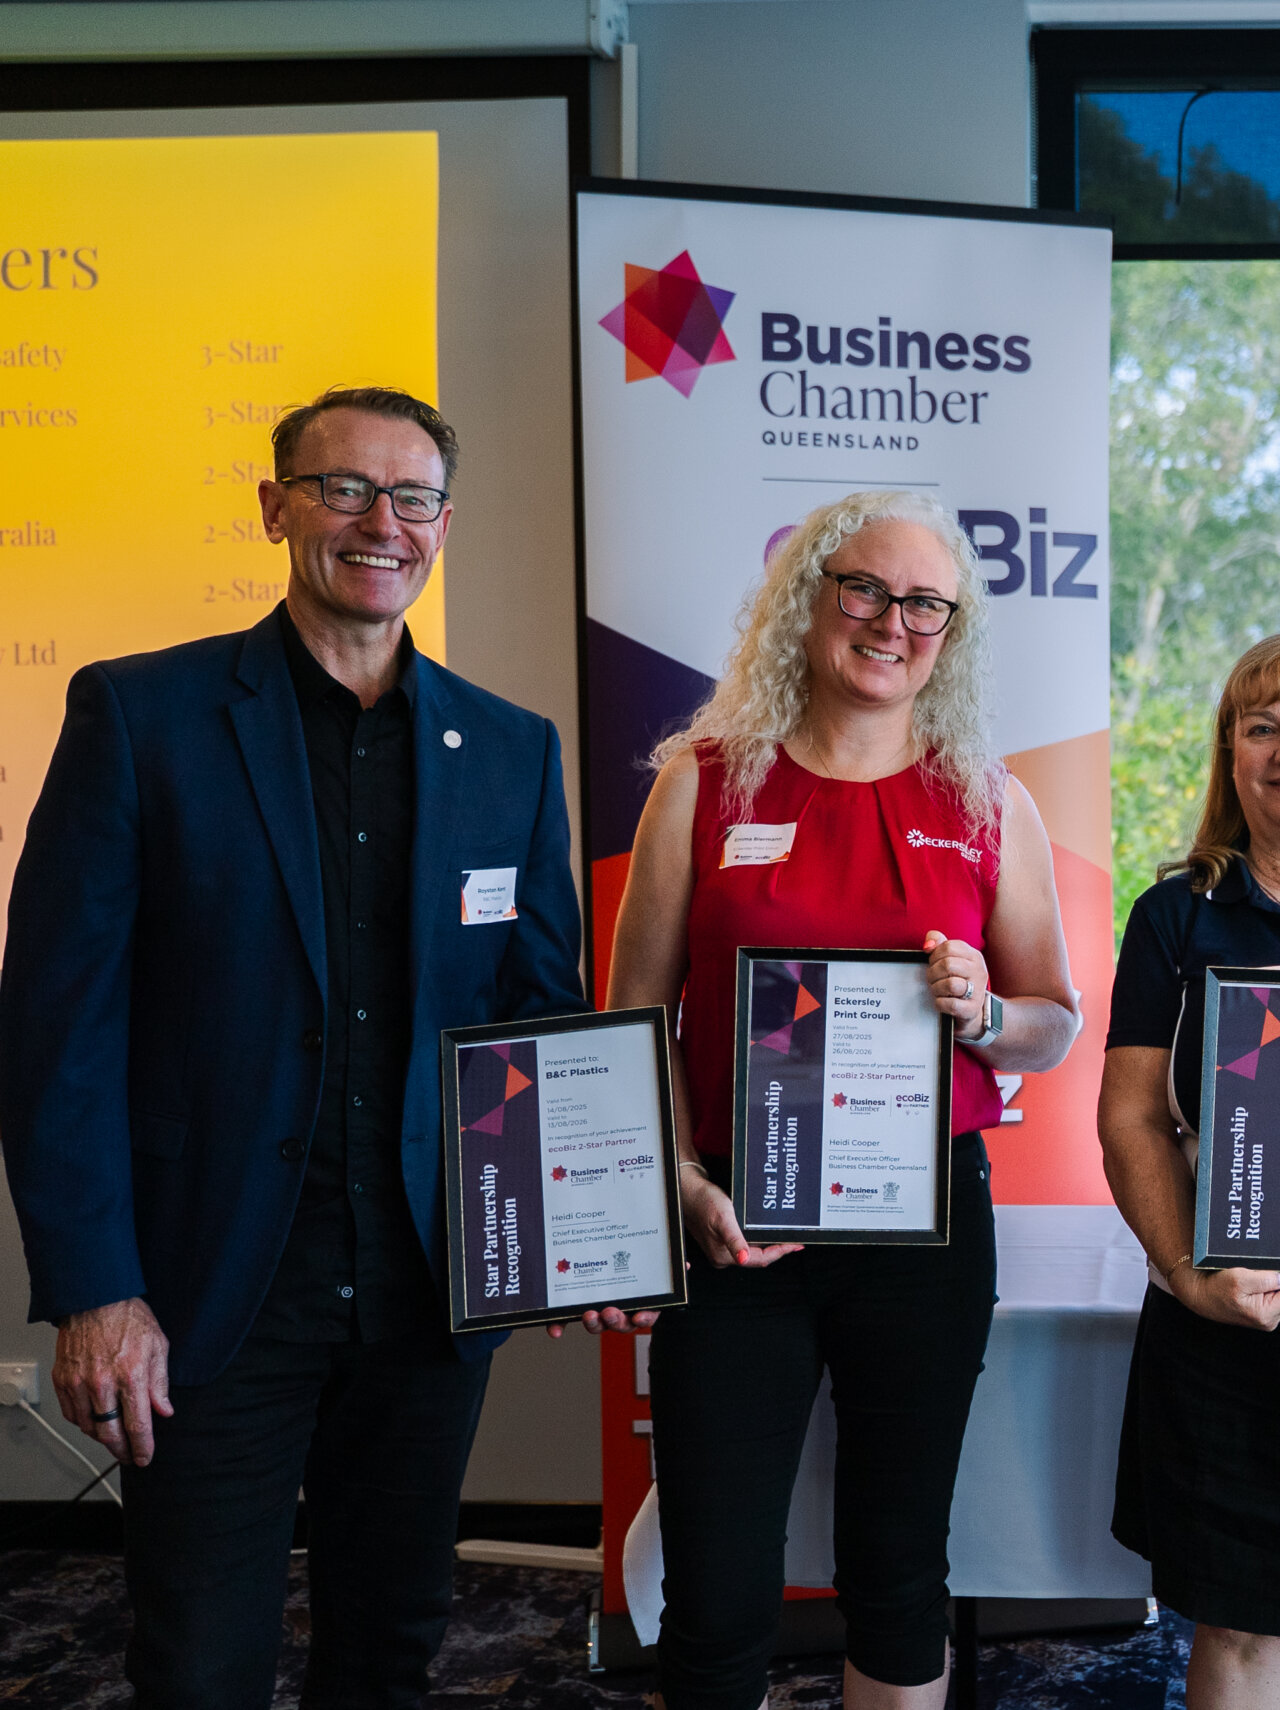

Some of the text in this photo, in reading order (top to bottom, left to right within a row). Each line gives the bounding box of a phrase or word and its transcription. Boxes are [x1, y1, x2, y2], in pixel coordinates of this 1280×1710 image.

[0, 247, 99, 291] ers
[760, 312, 1032, 373] Business
[0, 340, 284, 372] afety 3-Star
[759, 370, 989, 425] Chamber
[762, 430, 919, 451] QUEENSLAND
[203, 460, 270, 485] 2-Sta
[14, 640, 56, 666] Ltd
[925, 837, 983, 858] ECKERSLEY
[834, 985, 875, 994] Presented
[834, 997, 881, 1007] Eckersley
[833, 1011, 891, 1021] Print Group
[544, 1056, 587, 1066] Presented
[545, 1066, 609, 1080] B&C Plastics
[885, 1073, 915, 1081] Partner
[850, 1098, 886, 1106] Business
[895, 1093, 930, 1102] ecoBiz
[548, 1138, 637, 1153] ecoBiz 2-Star Partner
[762, 1080, 783, 1210] Star Partnership
[851, 1139, 880, 1147] Cooper
[618, 1154, 654, 1167] ecoBiz
[781, 1116, 799, 1210] Recognition
[570, 1167, 608, 1177] Business
[888, 1164, 927, 1172] Queensland
[1227, 1106, 1249, 1240] Star Partnership
[570, 1175, 602, 1184] Chamber
[1246, 1143, 1265, 1240] Recognition
[551, 1210, 606, 1222] Heidi Cooper
[479, 1163, 500, 1299] Star Partnership
[552, 1224, 629, 1238] Chief Executive Officer
[552, 1228, 659, 1246] Business Chamber Queensland
[501, 1197, 522, 1297] Recognition
[573, 1259, 608, 1269] Business
[573, 1267, 603, 1275] Chamber
